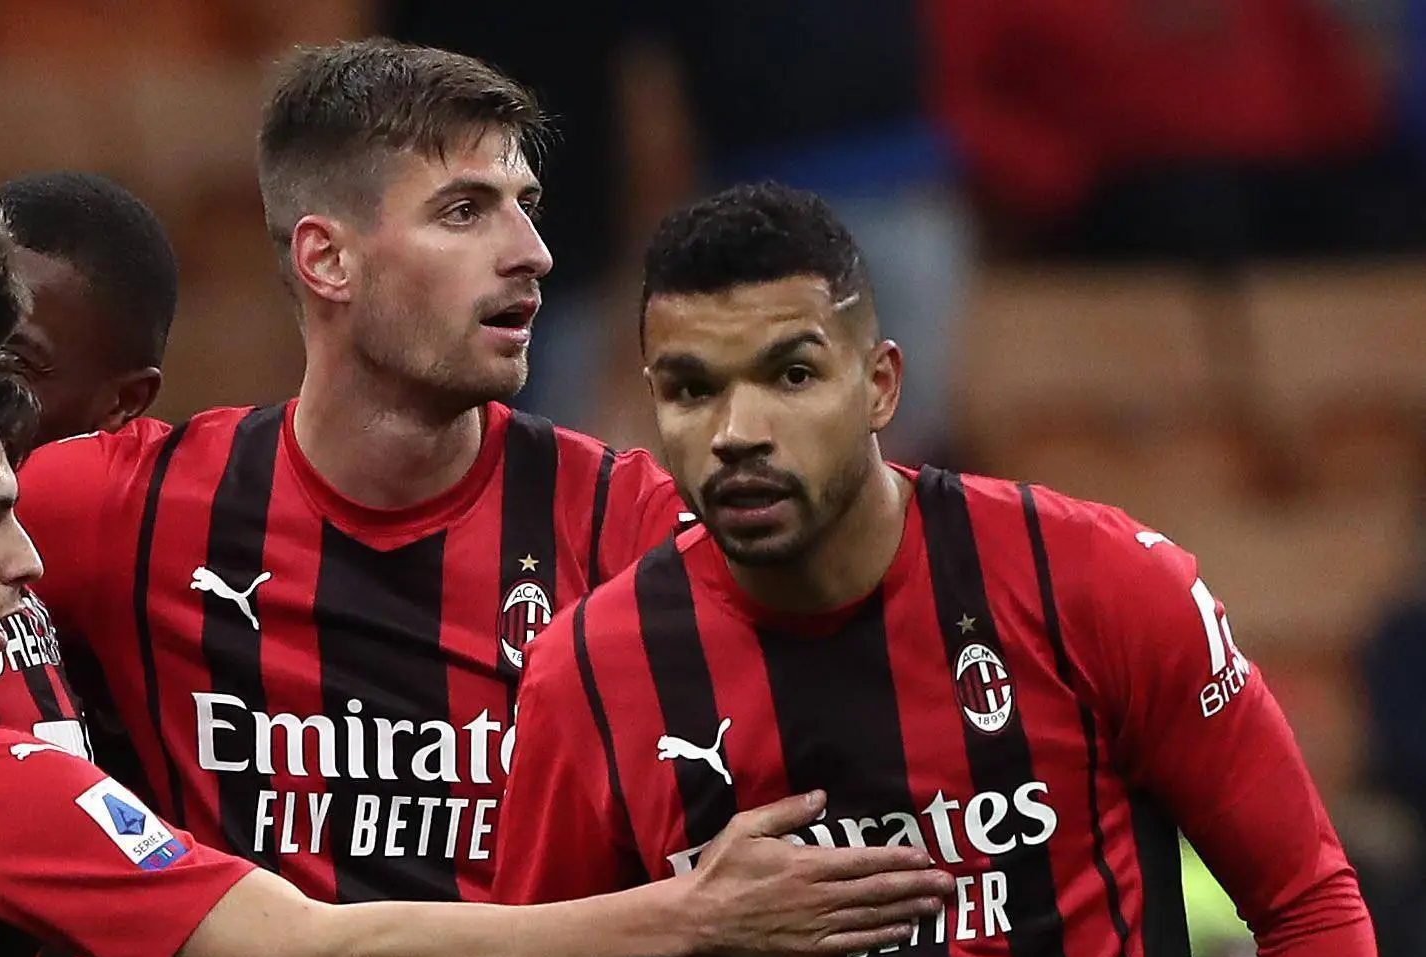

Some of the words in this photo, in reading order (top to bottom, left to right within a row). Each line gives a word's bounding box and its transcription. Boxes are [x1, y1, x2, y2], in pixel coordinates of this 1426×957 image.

[512, 586, 544, 603] ACM
[961, 647, 994, 667] ACM
[1200, 645, 1251, 718] BitM
[977, 711, 1006, 725] 1899
[191, 692, 517, 783] Emirat
[253, 790, 333, 854] FLY
[350, 795, 497, 860] BETTE
[133, 834, 159, 856] SERIE
